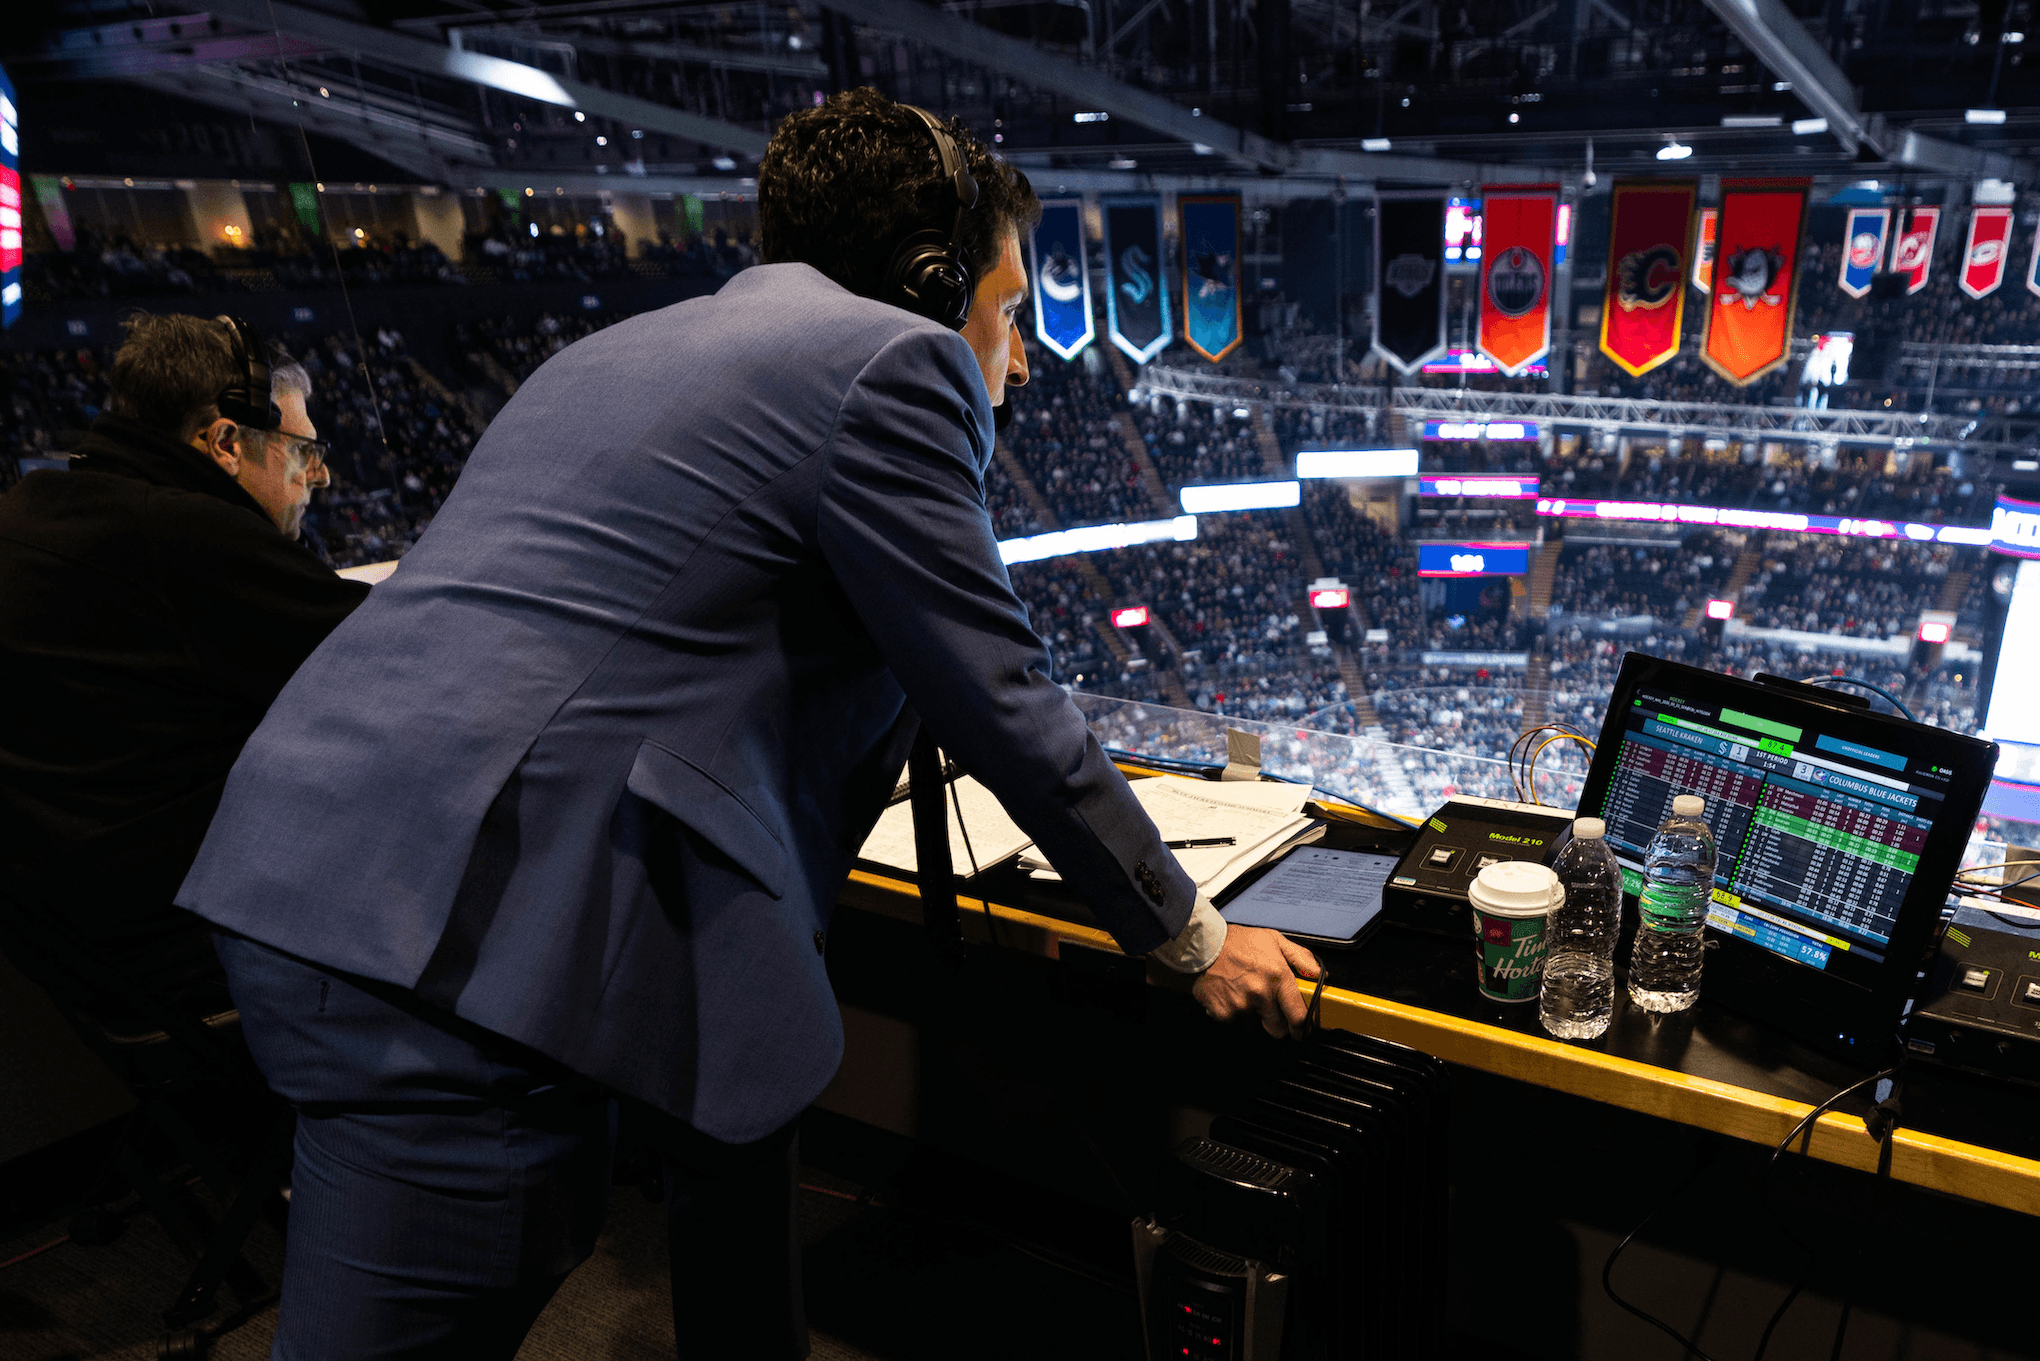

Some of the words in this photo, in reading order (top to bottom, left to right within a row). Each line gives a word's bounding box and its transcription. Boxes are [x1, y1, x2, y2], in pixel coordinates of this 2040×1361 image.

[1656, 725, 1680, 739] SEATTLE
[1680, 731, 1703, 744] KRAKEN
[1737, 746, 1742, 755] 1
[1863, 750, 1880, 759] LEADERS
[1756, 751, 1768, 759] 1ST
[1767, 753, 1789, 765] PERIOD
[1762, 761, 1776, 770] 1:54
[1801, 765, 1807, 774] 3
[1829, 776, 1868, 793] COLUMBUS
[1868, 786, 1887, 798] BLUE
[1887, 791, 1917, 807] JACKETS
[1489, 832, 1521, 843] Model
[1522, 837, 1543, 846] 210
[1624, 876, 1641, 890] 2.2%
[1800, 945, 1827, 961] 57.8%
[1493, 957, 1545, 979] Horto
